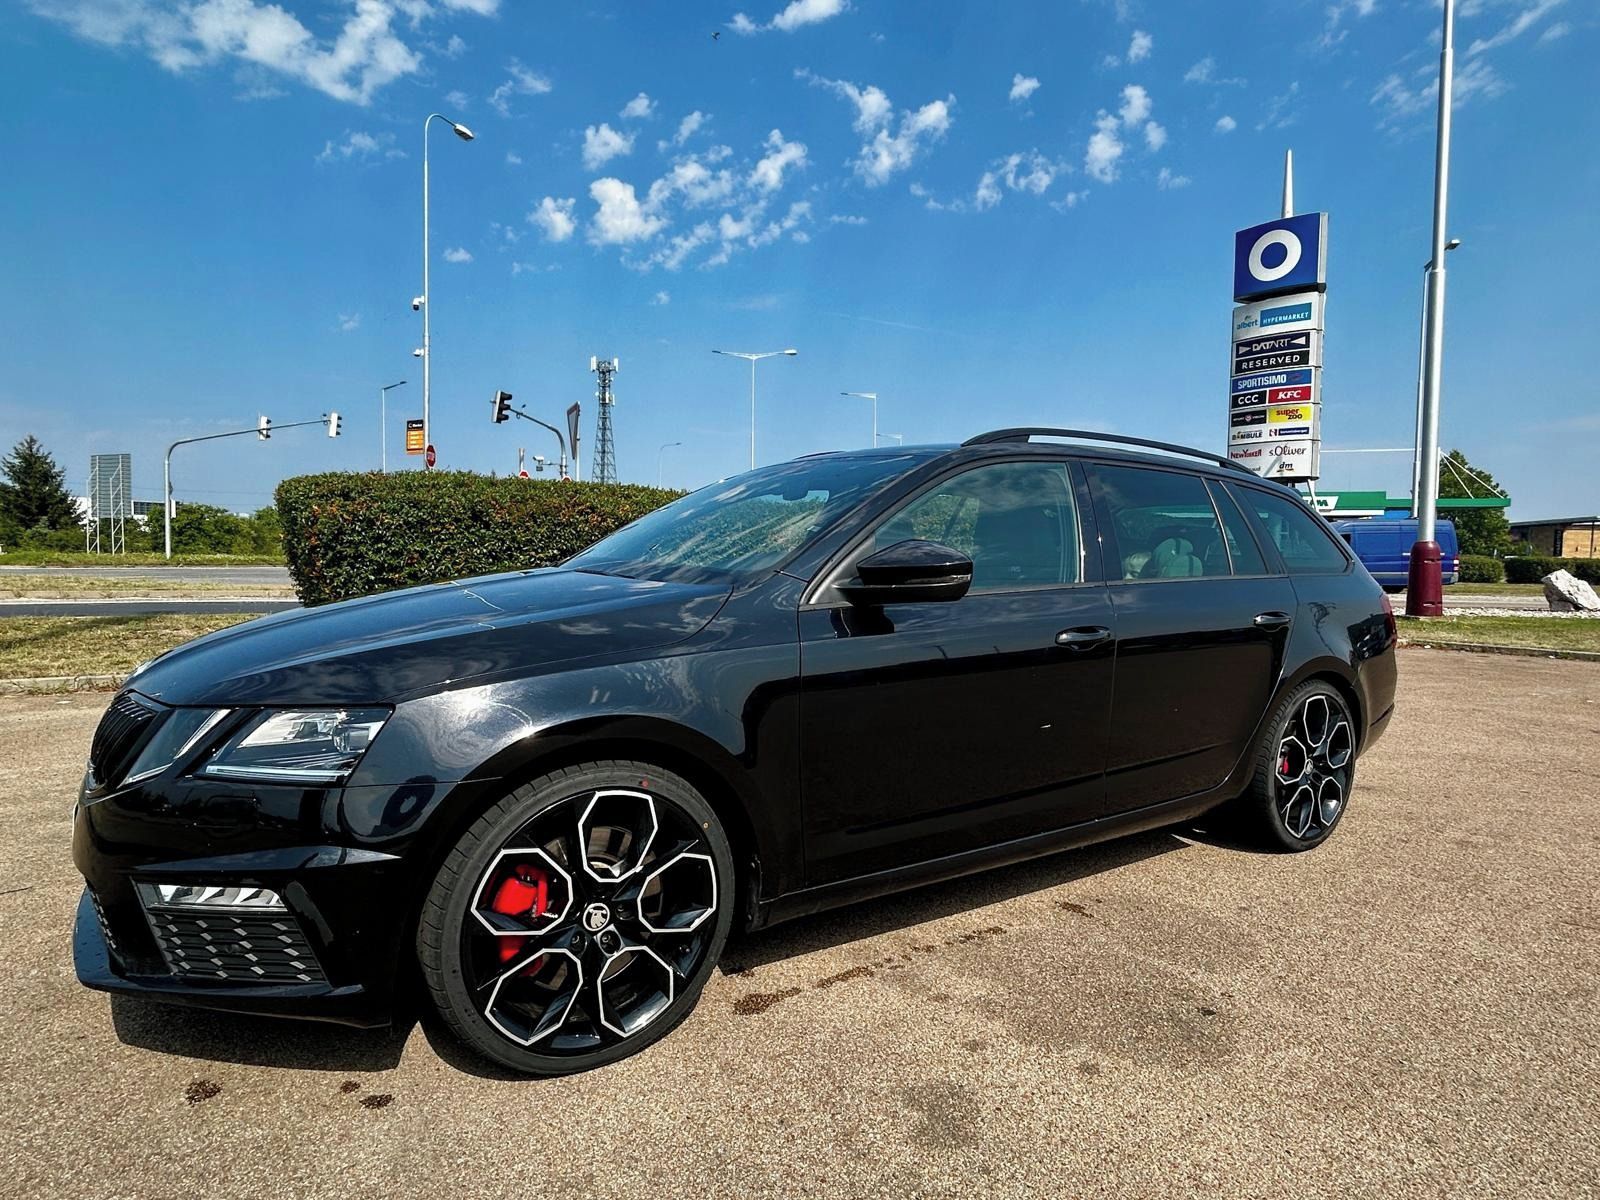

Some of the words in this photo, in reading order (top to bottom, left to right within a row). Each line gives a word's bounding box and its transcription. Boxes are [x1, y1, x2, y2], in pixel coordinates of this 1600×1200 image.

[1237, 319, 1258, 330] albert
[1263, 312, 1309, 324] HYPERMARKET
[1252, 338, 1291, 352] DATART
[1242, 354, 1300, 370] RESERVED
[1238, 374, 1287, 390] SPORTISIMO
[1238, 394, 1259, 405] CCC
[1277, 390, 1302, 400] KFC
[1276, 408, 1299, 418] super
[1269, 445, 1307, 457] s.Oliver
[1279, 461, 1293, 469] dm
